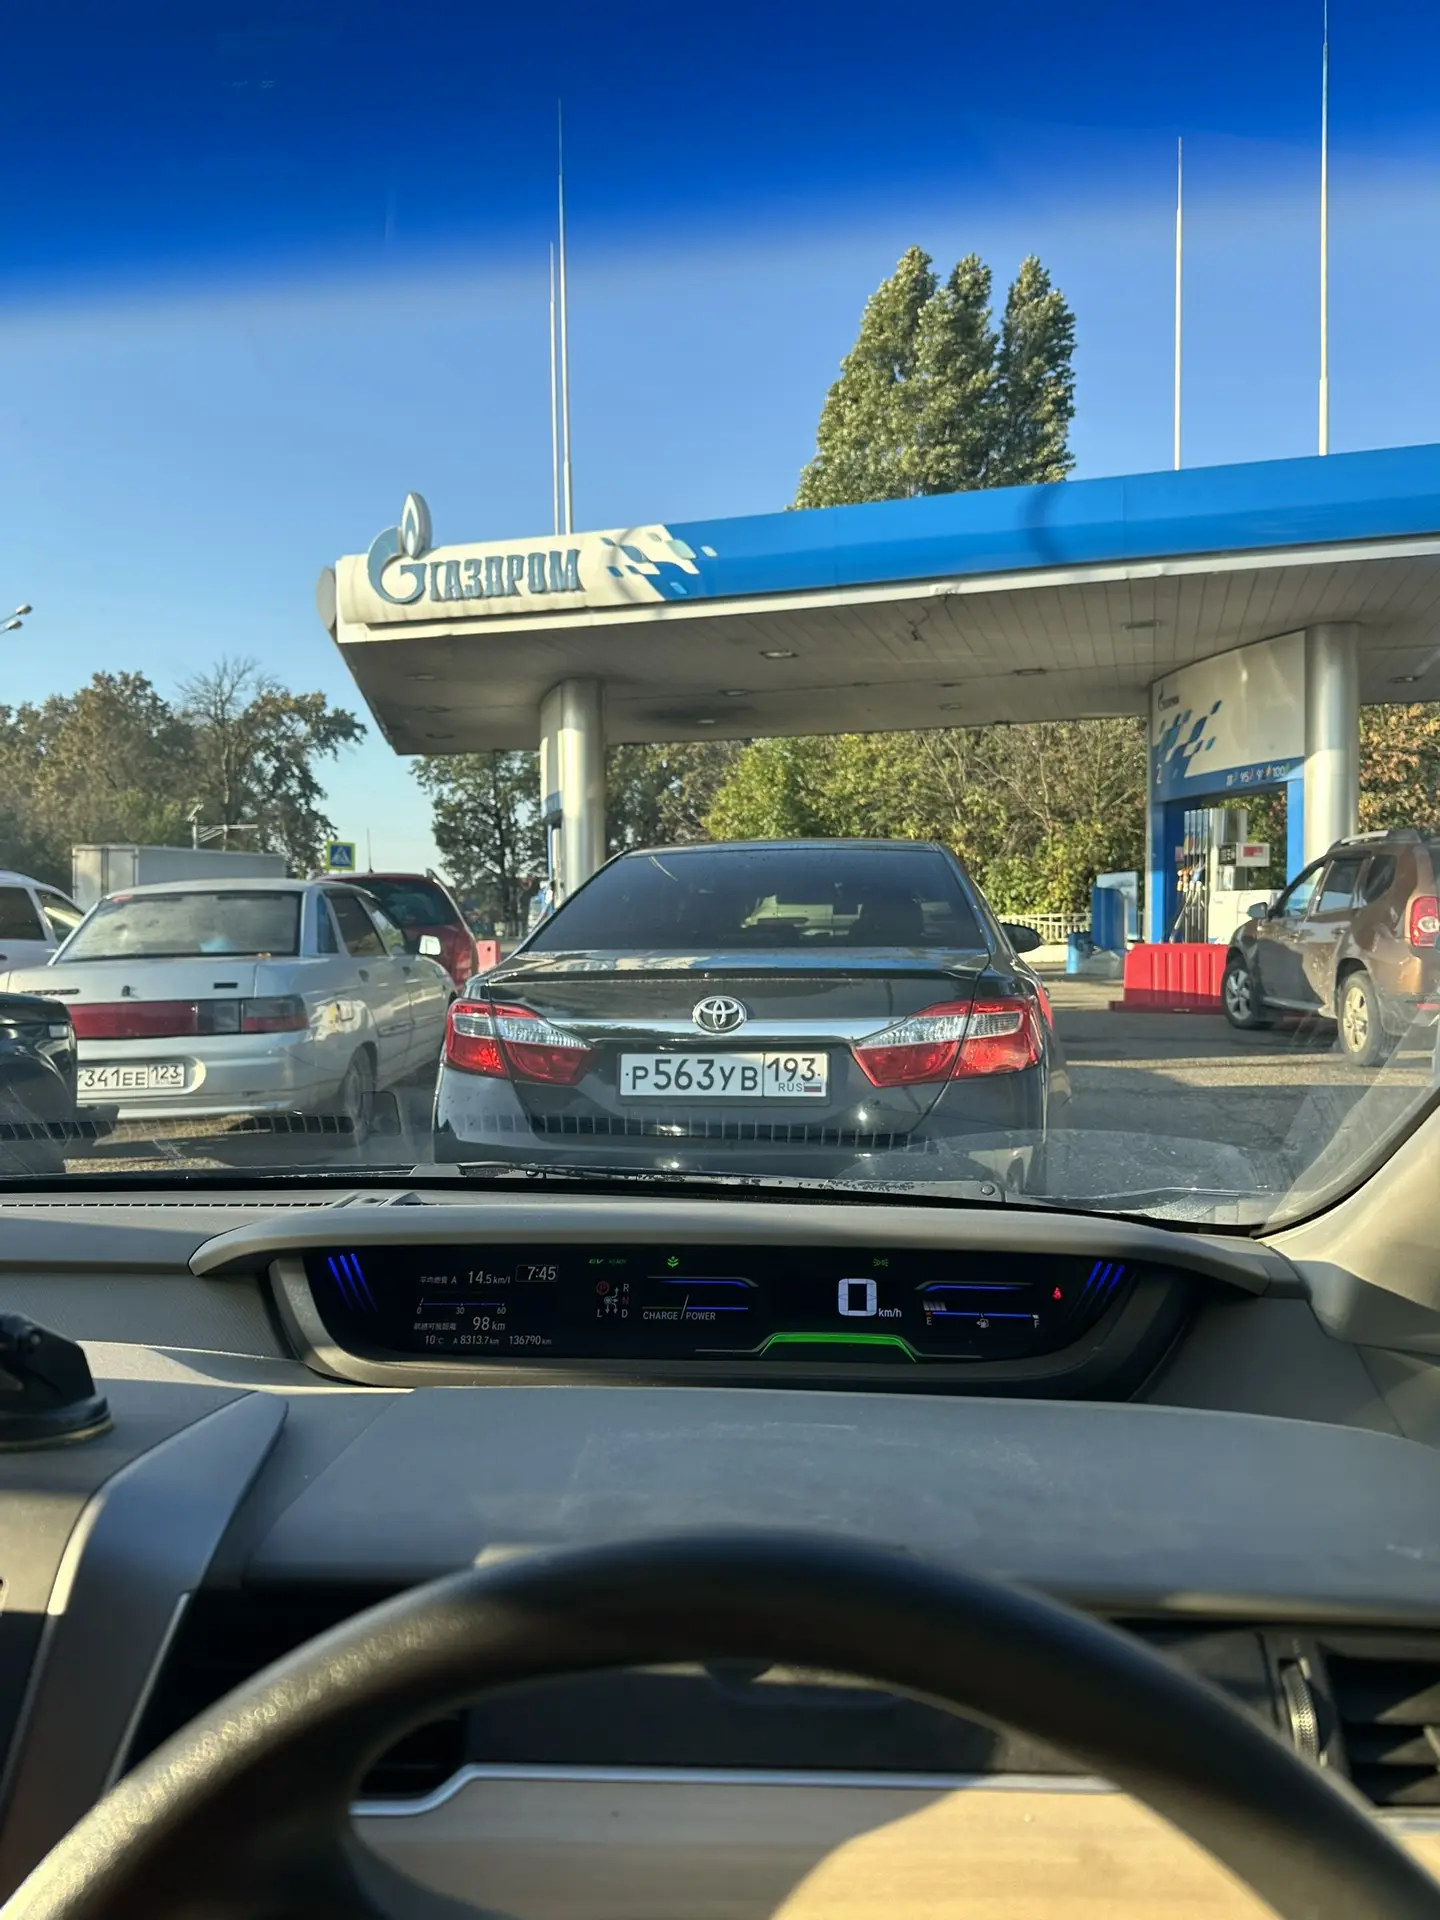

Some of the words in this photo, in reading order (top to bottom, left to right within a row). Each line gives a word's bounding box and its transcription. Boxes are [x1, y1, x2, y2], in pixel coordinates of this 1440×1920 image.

[429, 549, 585, 603] ГАЗПРОМ
[77, 1068, 146, 1088] 341ЕЕ
[151, 1064, 179, 1080] 123
[631, 1058, 758, 1091] Р563УВ
[766, 1057, 816, 1083] 193
[777, 1082, 803, 1093] RUS
[450, 1276, 457, 1285] A
[468, 1270, 492, 1285] 14.5
[527, 1266, 557, 1281] 7:45
[623, 1284, 630, 1293] R
[838, 1278, 877, 1317] 0
[878, 1308, 902, 1318] km/h
[416, 1307, 422, 1315] 0
[456, 1307, 465, 1315] 30
[497, 1307, 507, 1315] 60
[596, 1309, 602, 1318] L
[621, 1309, 629, 1318] D
[642, 1311, 678, 1320] CHARGE
[686, 1311, 716, 1321] POWER
[472, 1316, 490, 1331] 98
[491, 1321, 506, 1331] km
[926, 1316, 932, 1326] E
